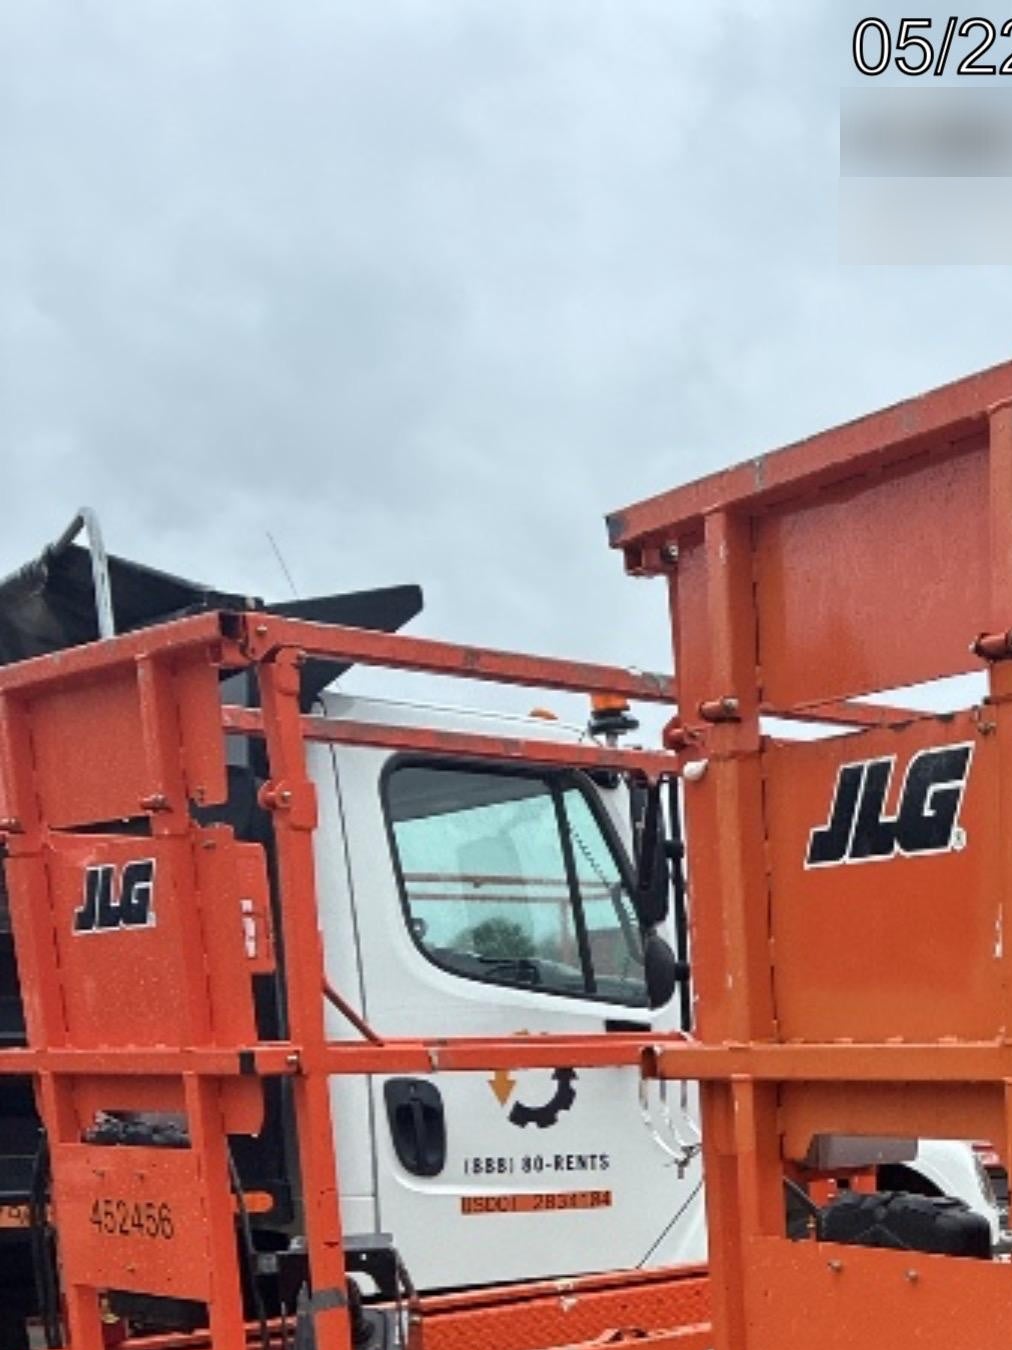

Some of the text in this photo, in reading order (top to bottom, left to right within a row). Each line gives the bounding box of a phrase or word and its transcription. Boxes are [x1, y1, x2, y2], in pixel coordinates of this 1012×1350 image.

[804, 741, 975, 870] JLG
[73, 859, 156, 935] JLG
[521, 1154, 610, 1174] 80-RENTS
[90, 1198, 175, 1241] 452456
